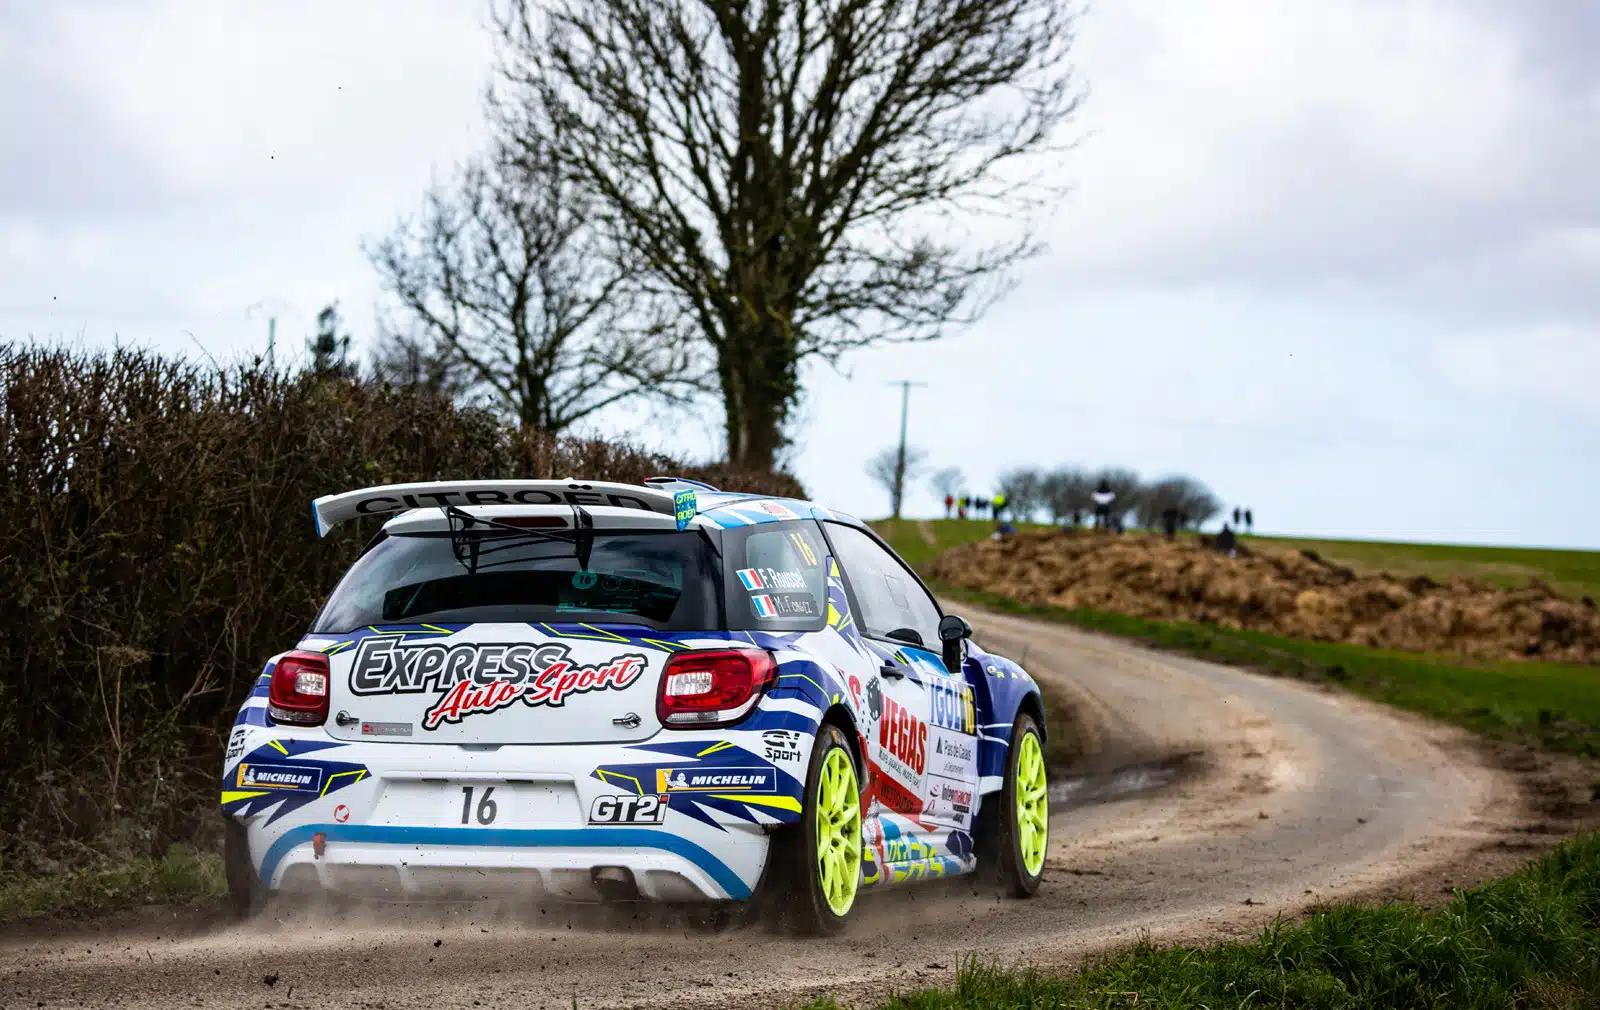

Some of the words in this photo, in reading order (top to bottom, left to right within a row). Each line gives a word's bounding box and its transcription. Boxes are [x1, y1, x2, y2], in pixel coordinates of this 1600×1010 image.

[790, 532, 818, 566] 16
[579, 574, 592, 585] 16
[352, 637, 568, 691] EXPRESS
[429, 679, 524, 724] Auto
[530, 658, 646, 702] Sport
[930, 676, 960, 730] IGOL
[962, 687, 975, 734] 16
[879, 690, 927, 776] VEGAS
[256, 772, 312, 785] MICHELIN
[691, 775, 767, 786] MICHELIN
[461, 786, 498, 825] 16
[589, 794, 670, 823] GT2i
